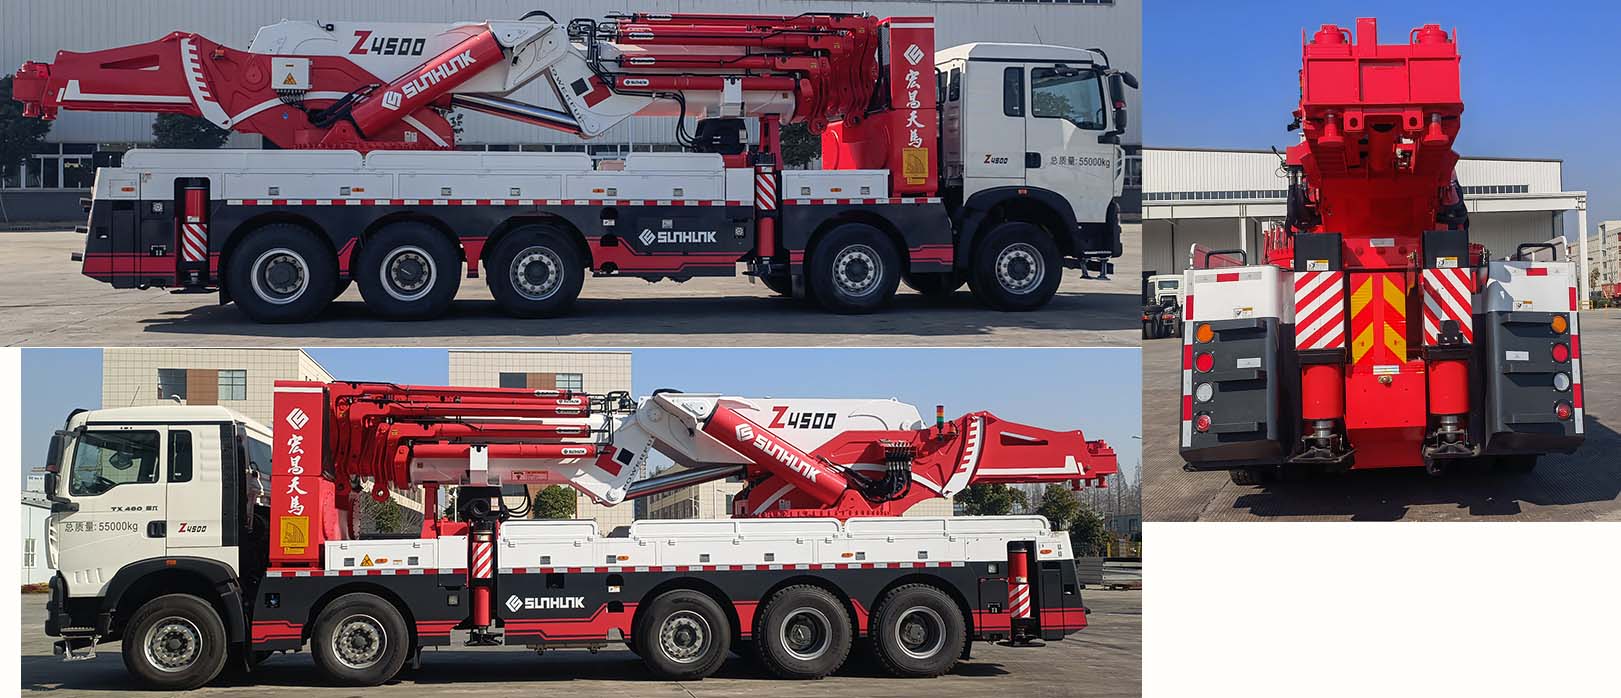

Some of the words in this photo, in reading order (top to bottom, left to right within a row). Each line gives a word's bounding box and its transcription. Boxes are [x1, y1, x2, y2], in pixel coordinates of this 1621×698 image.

[349, 31, 426, 56] Z4500
[984, 154, 1008, 164] Z4500
[768, 406, 837, 429] Z4500
[178, 523, 207, 533] Z4500
